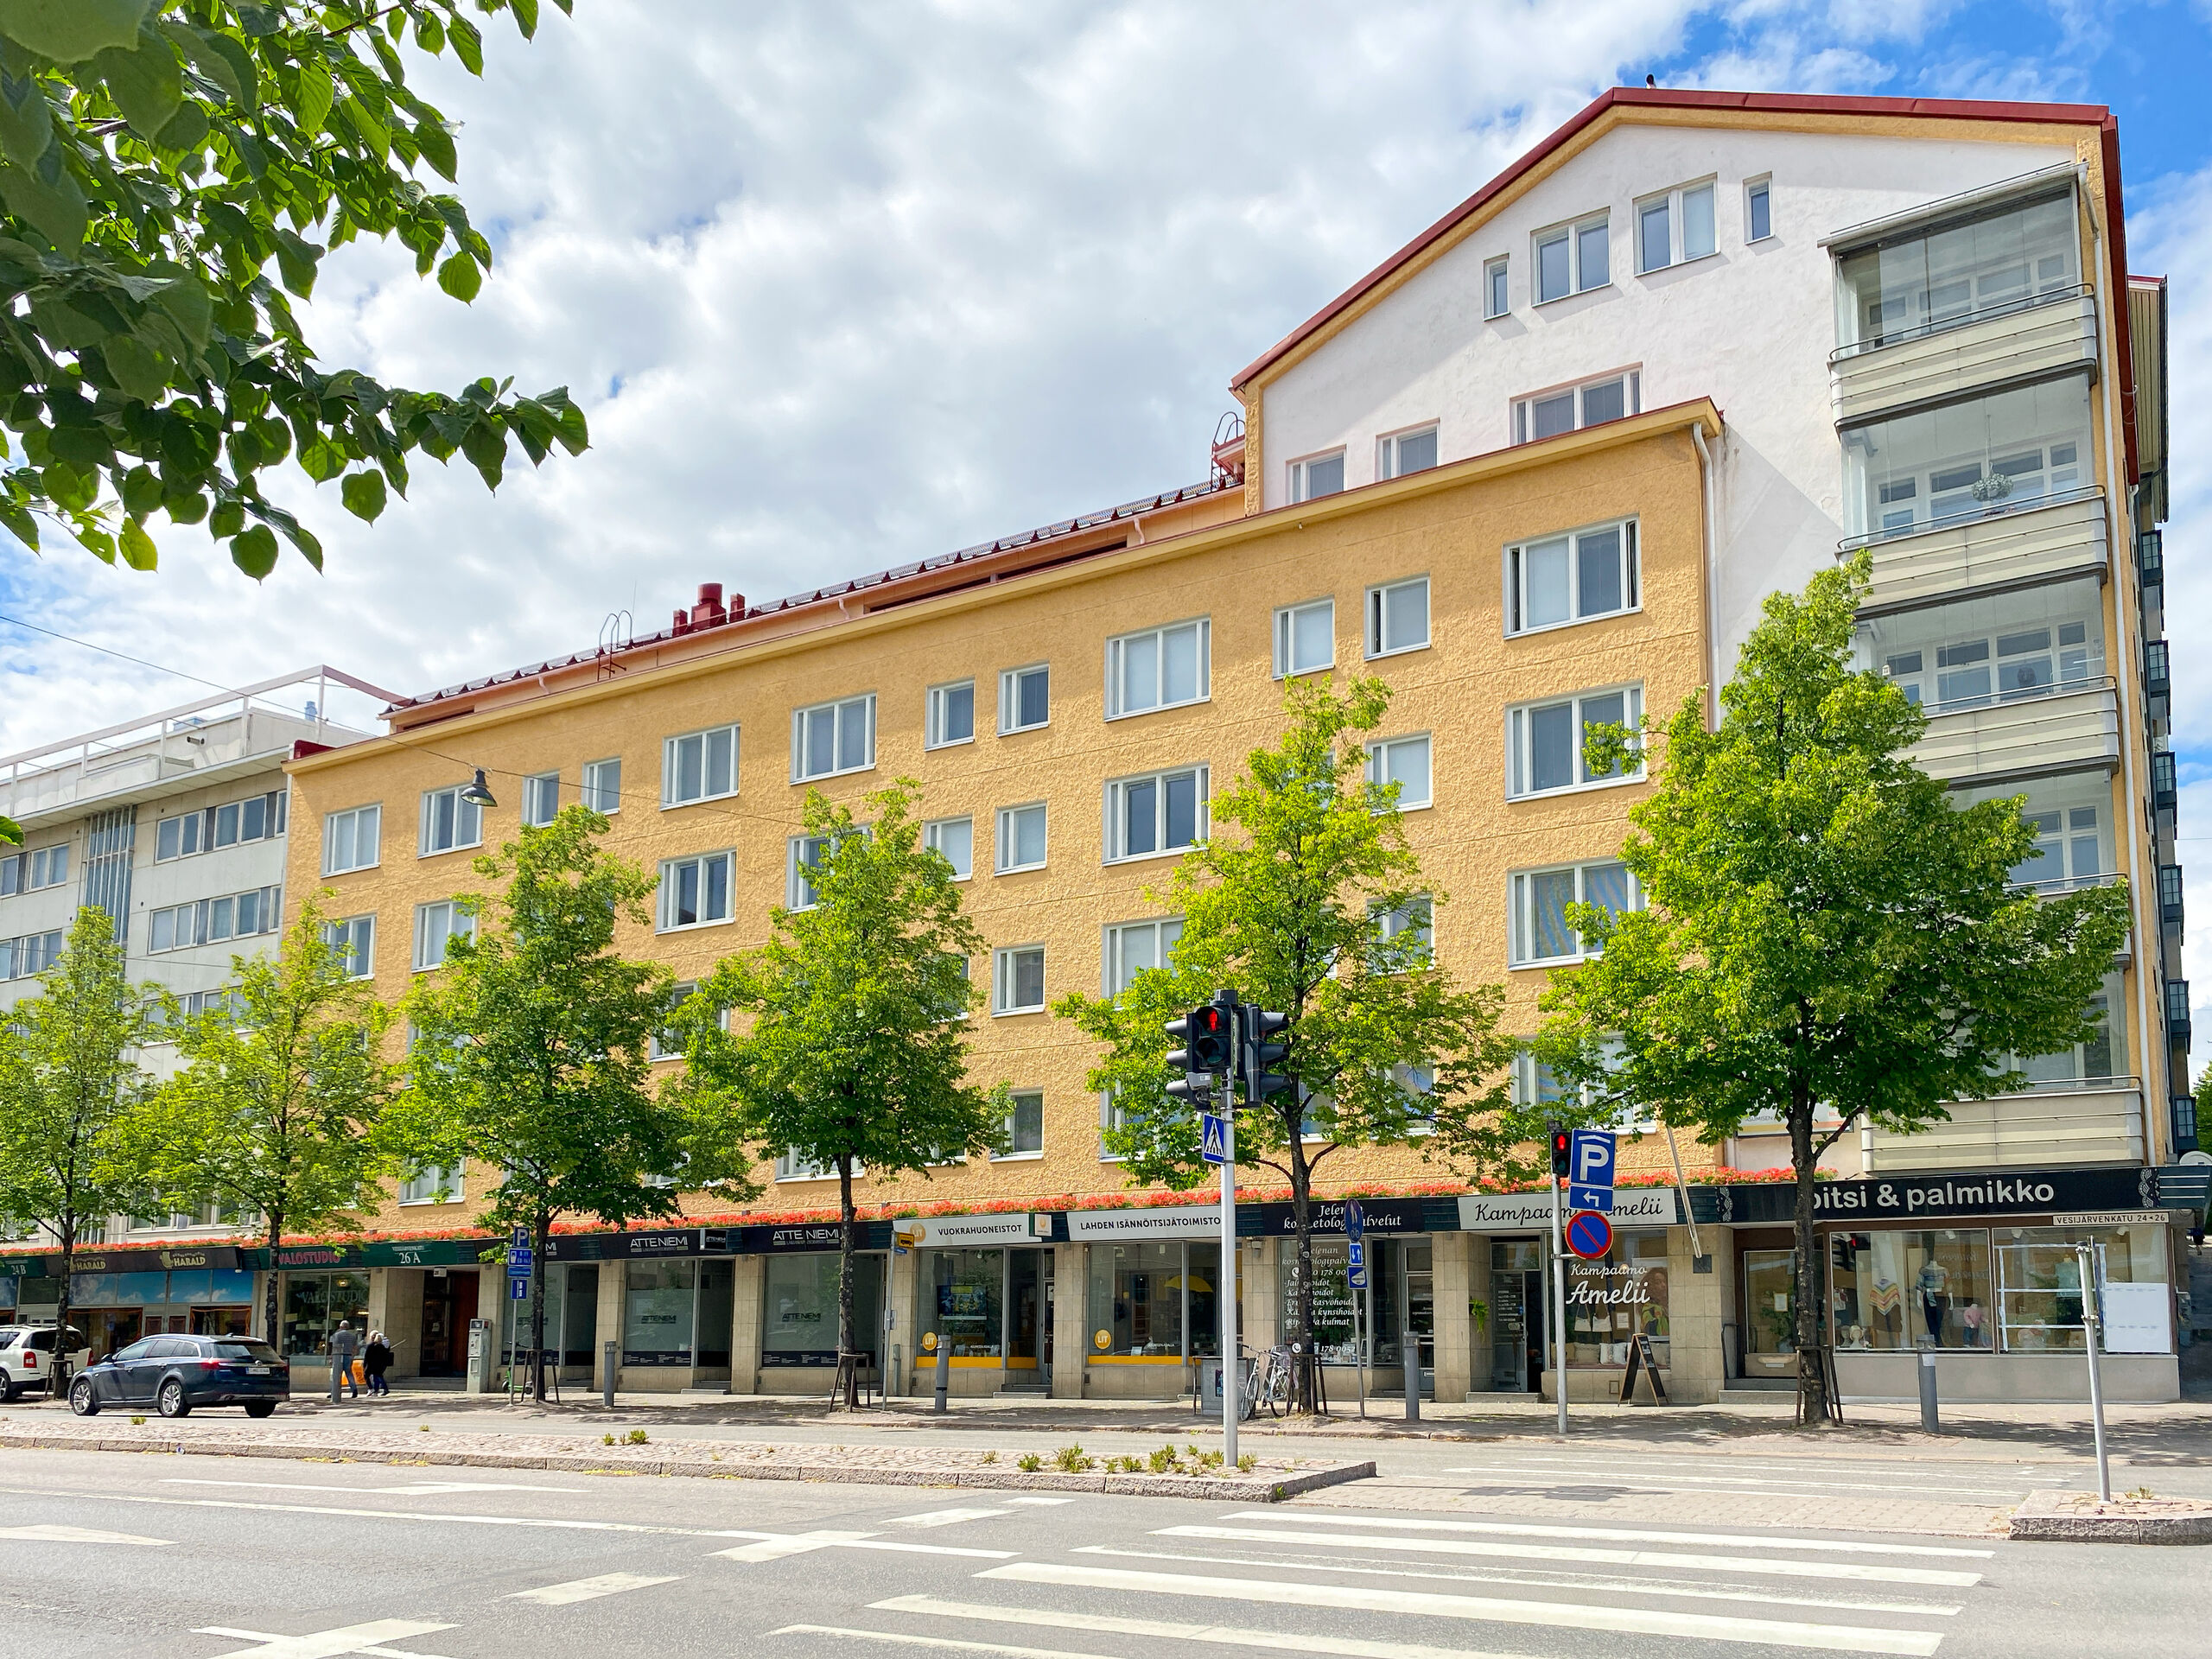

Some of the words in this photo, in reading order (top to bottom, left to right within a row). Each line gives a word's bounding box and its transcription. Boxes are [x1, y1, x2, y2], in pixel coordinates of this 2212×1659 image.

[1579, 1143, 1609, 1181] P
[1877, 1184, 1900, 1207] &
[1907, 1179, 2055, 1211] palmikko
[1318, 1204, 1363, 1217] Jele
[1475, 1203, 1579, 1225] Kampaam
[1605, 1197, 1663, 1217] melii
[1080, 1221, 1115, 1230] LAHDEN
[1116, 1217, 1221, 1229] ISÄNNÖITSIJÄTOIMISTO
[1284, 1213, 1402, 1230] koetologlvelut
[772, 1230, 804, 1240] ATTE
[805, 1229, 839, 1239] NIEMI
[938, 1224, 1022, 1236] VUOKRAHUONEISTOT
[517, 1229, 529, 1246] P
[1311, 1245, 1338, 1255] elenan
[174, 1256, 207, 1267] HARALD
[398, 1252, 411, 1264] 26
[412, 1251, 422, 1263] A
[76, 1262, 106, 1270] HARALD
[1570, 1263, 1648, 1279] Kampaamo
[1566, 1280, 1650, 1305] Amelii
[1318, 1307, 1363, 1319] kynsihoidt
[1322, 1317, 1350, 1325] kulmat
[1097, 1335, 1109, 1344] LIT
[1321, 1344, 1334, 1353] 178
